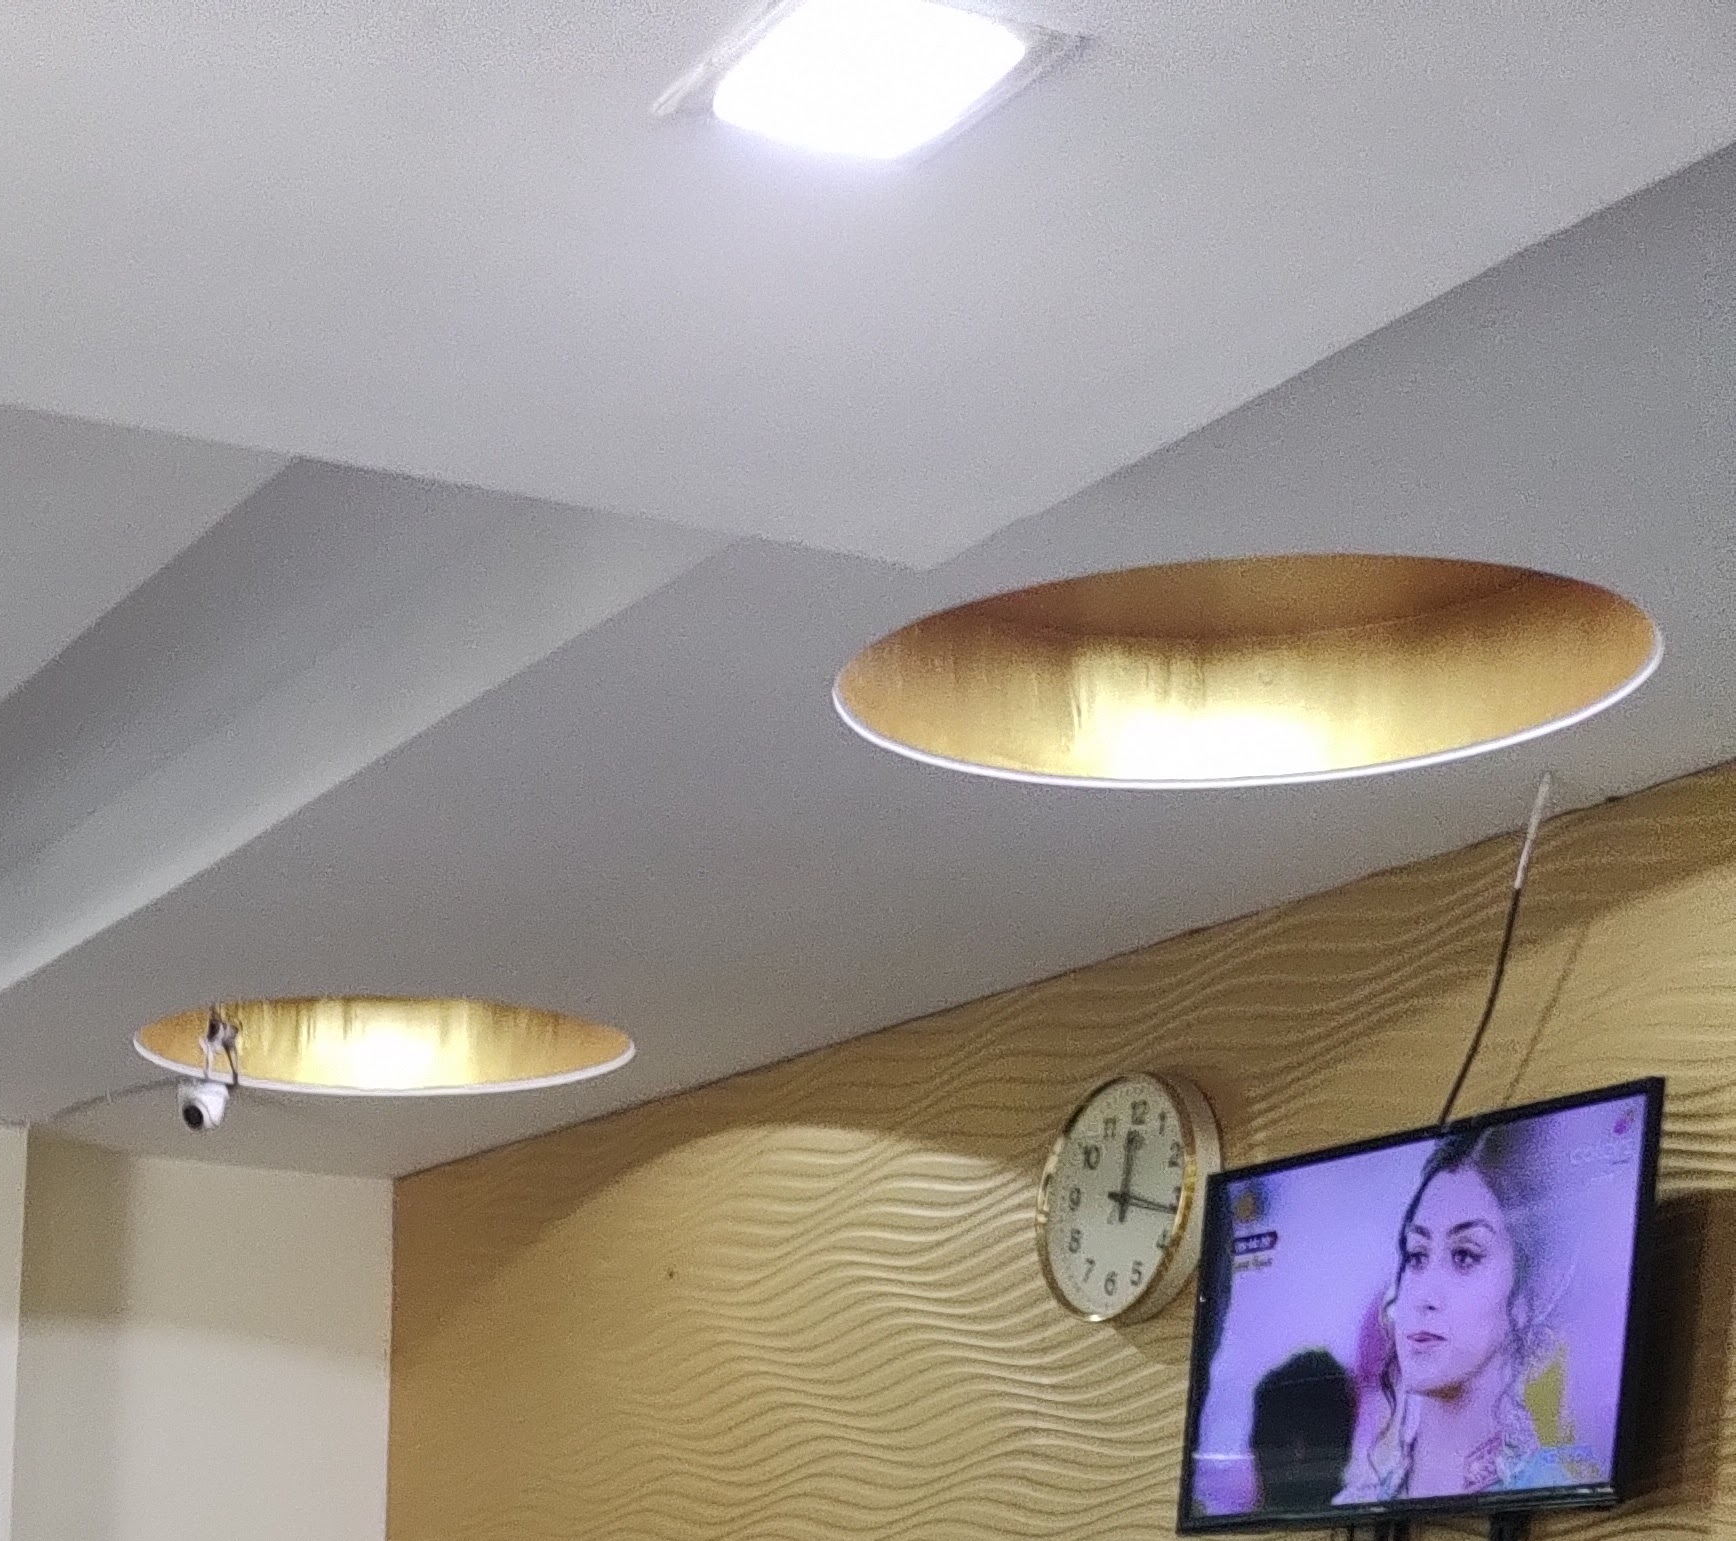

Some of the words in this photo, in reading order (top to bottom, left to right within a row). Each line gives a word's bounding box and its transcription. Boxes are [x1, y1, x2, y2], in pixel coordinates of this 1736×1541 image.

[1131, 1099, 1148, 1124] 12
[1158, 1111, 1166, 1135] 1
[1104, 1117, 1117, 1138] 11
[1082, 1143, 1100, 1170] 10
[1169, 1142, 1181, 1168] 2
[1069, 1187, 1081, 1210] 9
[1068, 1229, 1081, 1254] 8
[1084, 1257, 1096, 1283] 7
[1131, 1260, 1145, 1286] 5
[1105, 1271, 1118, 1296] 6
